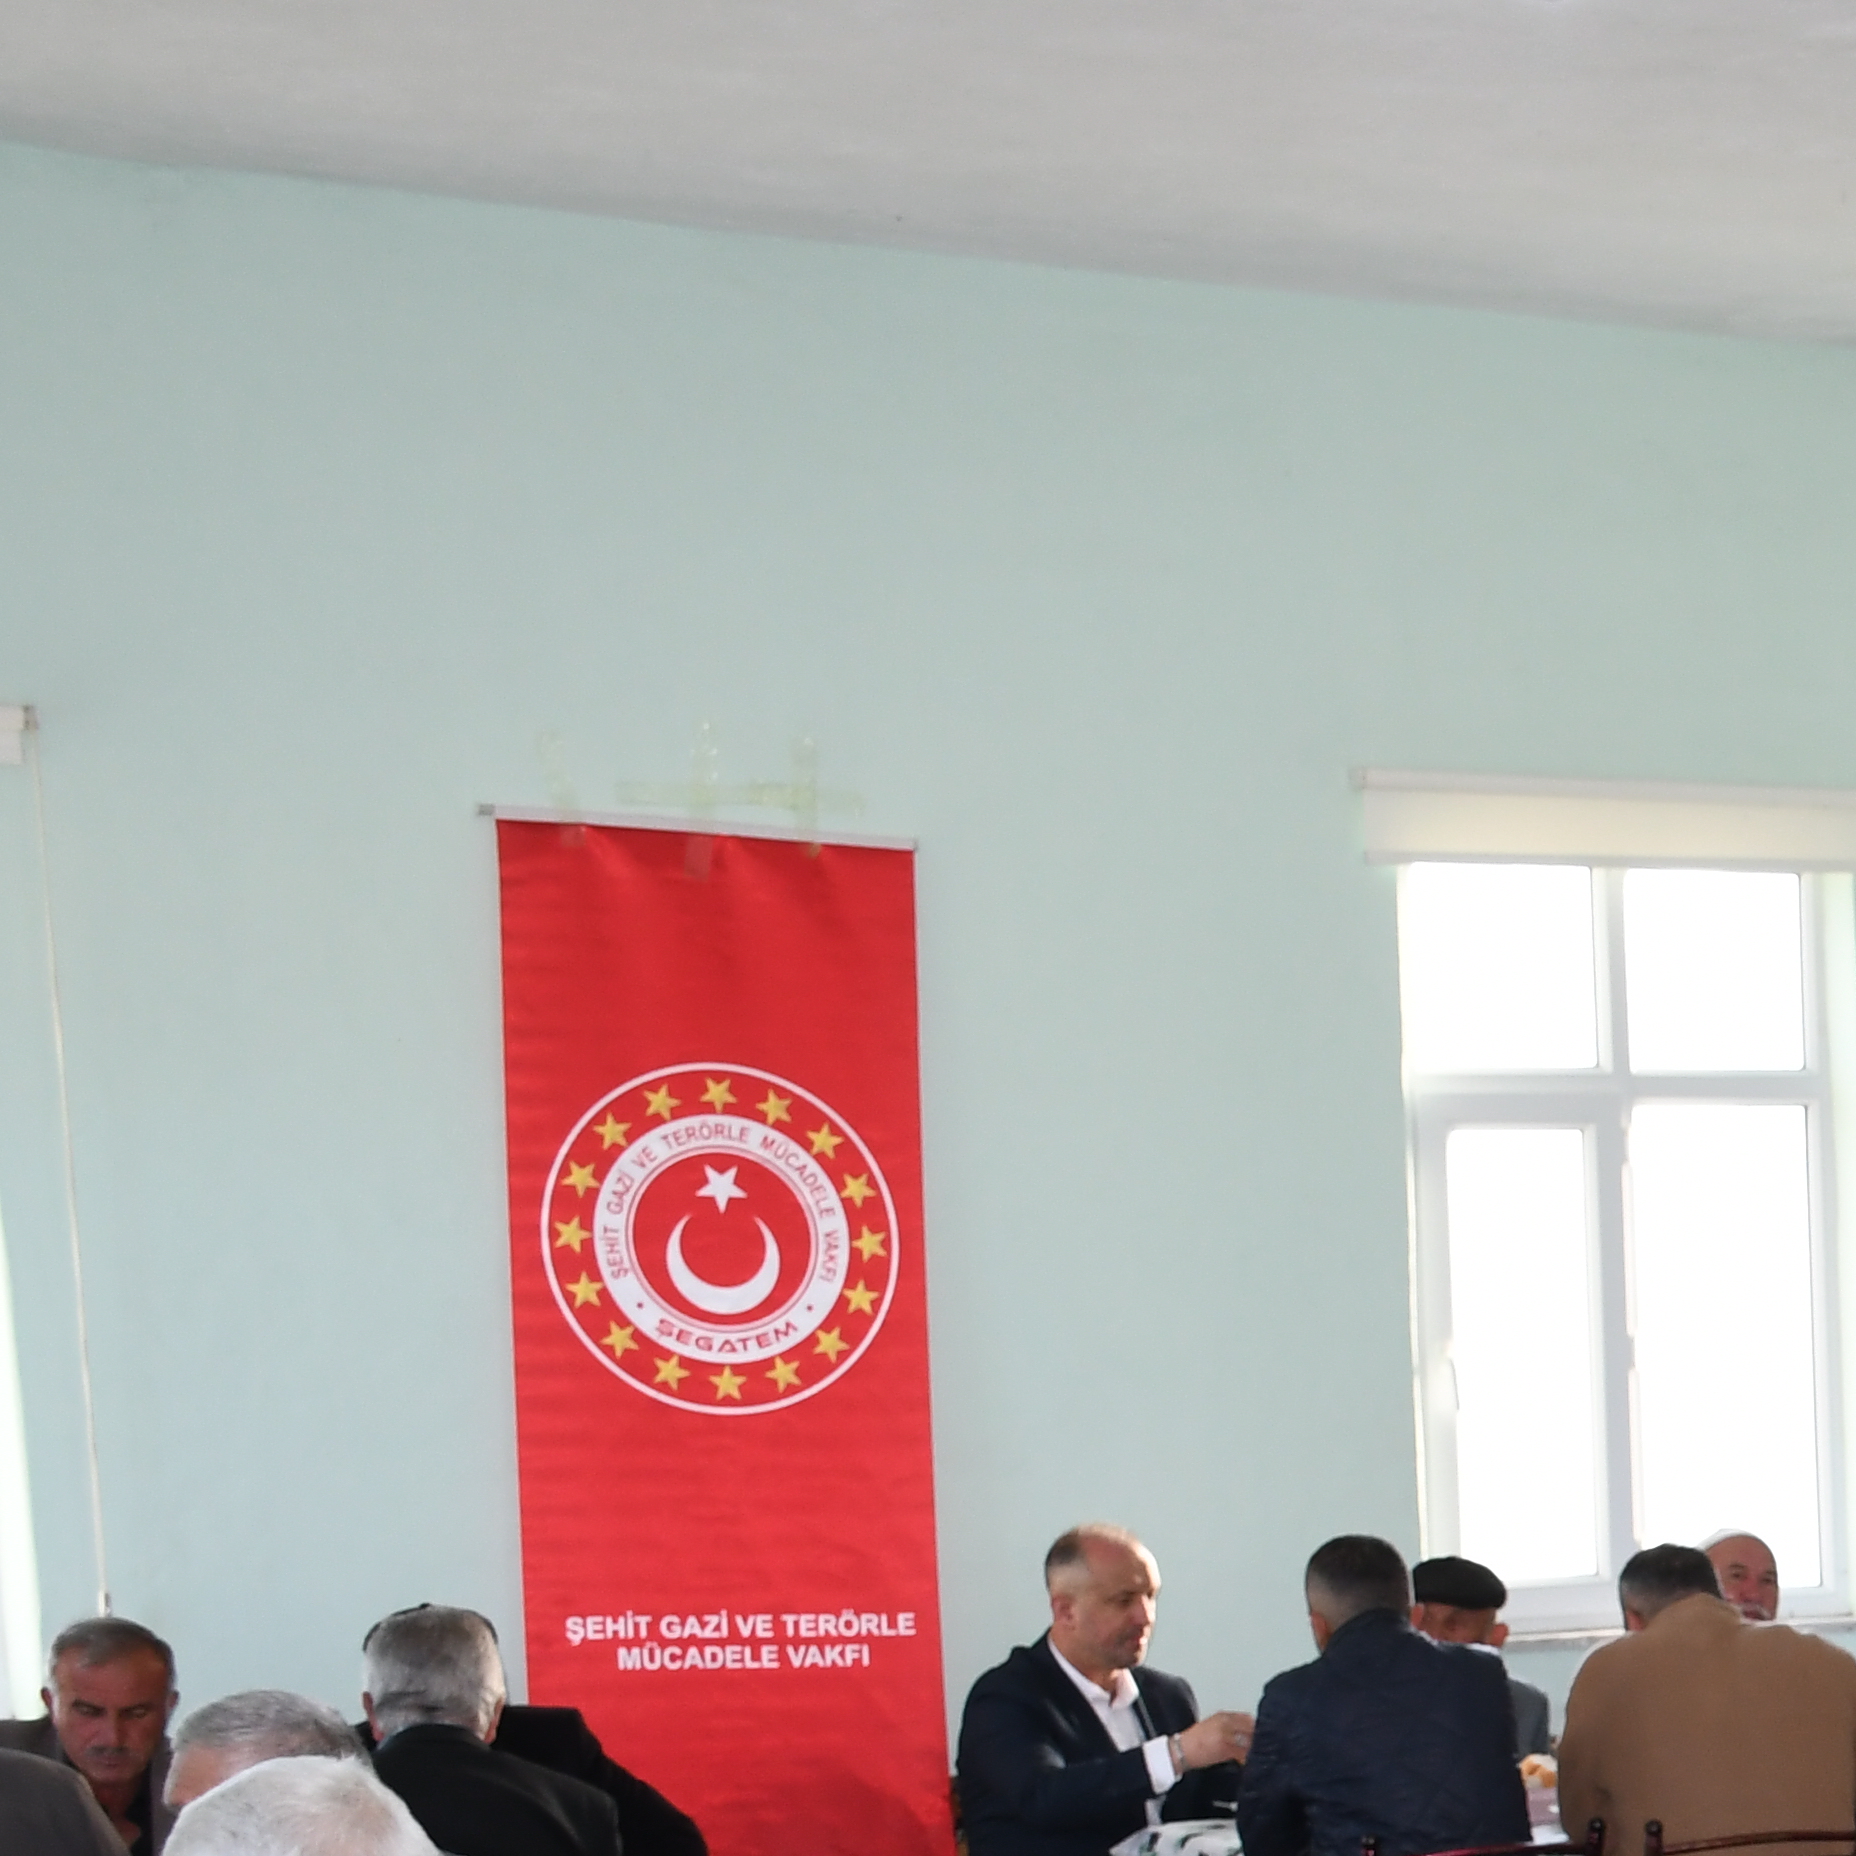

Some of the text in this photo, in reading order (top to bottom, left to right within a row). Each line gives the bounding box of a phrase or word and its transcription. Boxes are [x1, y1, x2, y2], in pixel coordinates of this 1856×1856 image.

[630, 1145, 658, 1169] VE
[660, 1119, 750, 1150] TERÖRLE
[759, 1134, 837, 1219] MÜCADELE
[819, 1229, 840, 1283] VAKFI
[565, 1607, 917, 1647] ŞEHİT GAZİ VE TERÖRLE
[617, 1641, 871, 1671] MÜCADELE VAKFI
